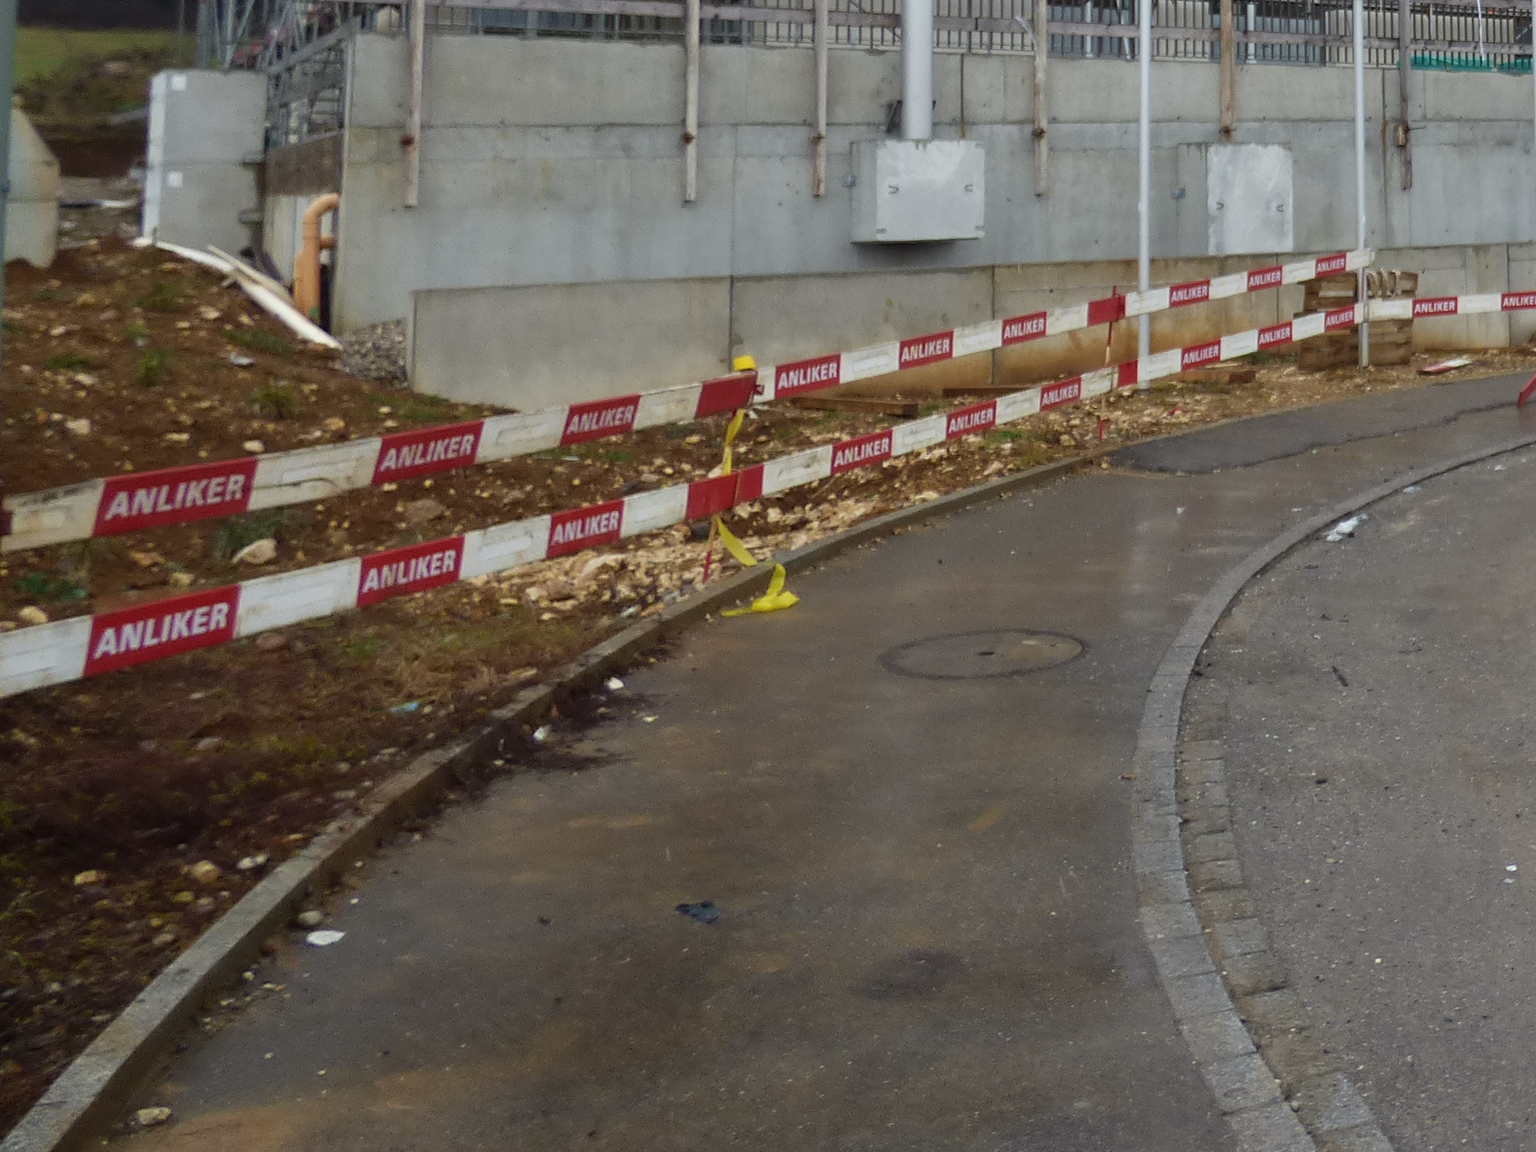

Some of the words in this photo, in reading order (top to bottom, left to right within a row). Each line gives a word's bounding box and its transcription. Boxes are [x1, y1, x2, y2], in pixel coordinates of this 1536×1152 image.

[1249, 269, 1280, 288] ANLIKER
[1316, 257, 1347, 275] ANLIKER
[1170, 284, 1209, 304] ANLIKER
[1326, 310, 1354, 327] ANLIKER
[1414, 300, 1457, 315] ANLIKER
[1003, 317, 1045, 339] ANLIKER
[1258, 326, 1292, 345] ANLIKER
[903, 338, 950, 363] ANLIKER
[1183, 345, 1220, 366] ANLIKER
[778, 362, 840, 389] ANLIKER
[1042, 383, 1081, 407] ANLIKER
[568, 405, 636, 435] ANLIKER
[948, 408, 994, 434] ANLIKER
[381, 434, 475, 472] ANLIKER
[833, 438, 890, 467] ANLIKER
[105, 474, 246, 521] ANLIKER
[553, 511, 619, 546] ANLIKER
[363, 550, 457, 594] ANLIKER
[94, 602, 230, 659] ANLIKER
